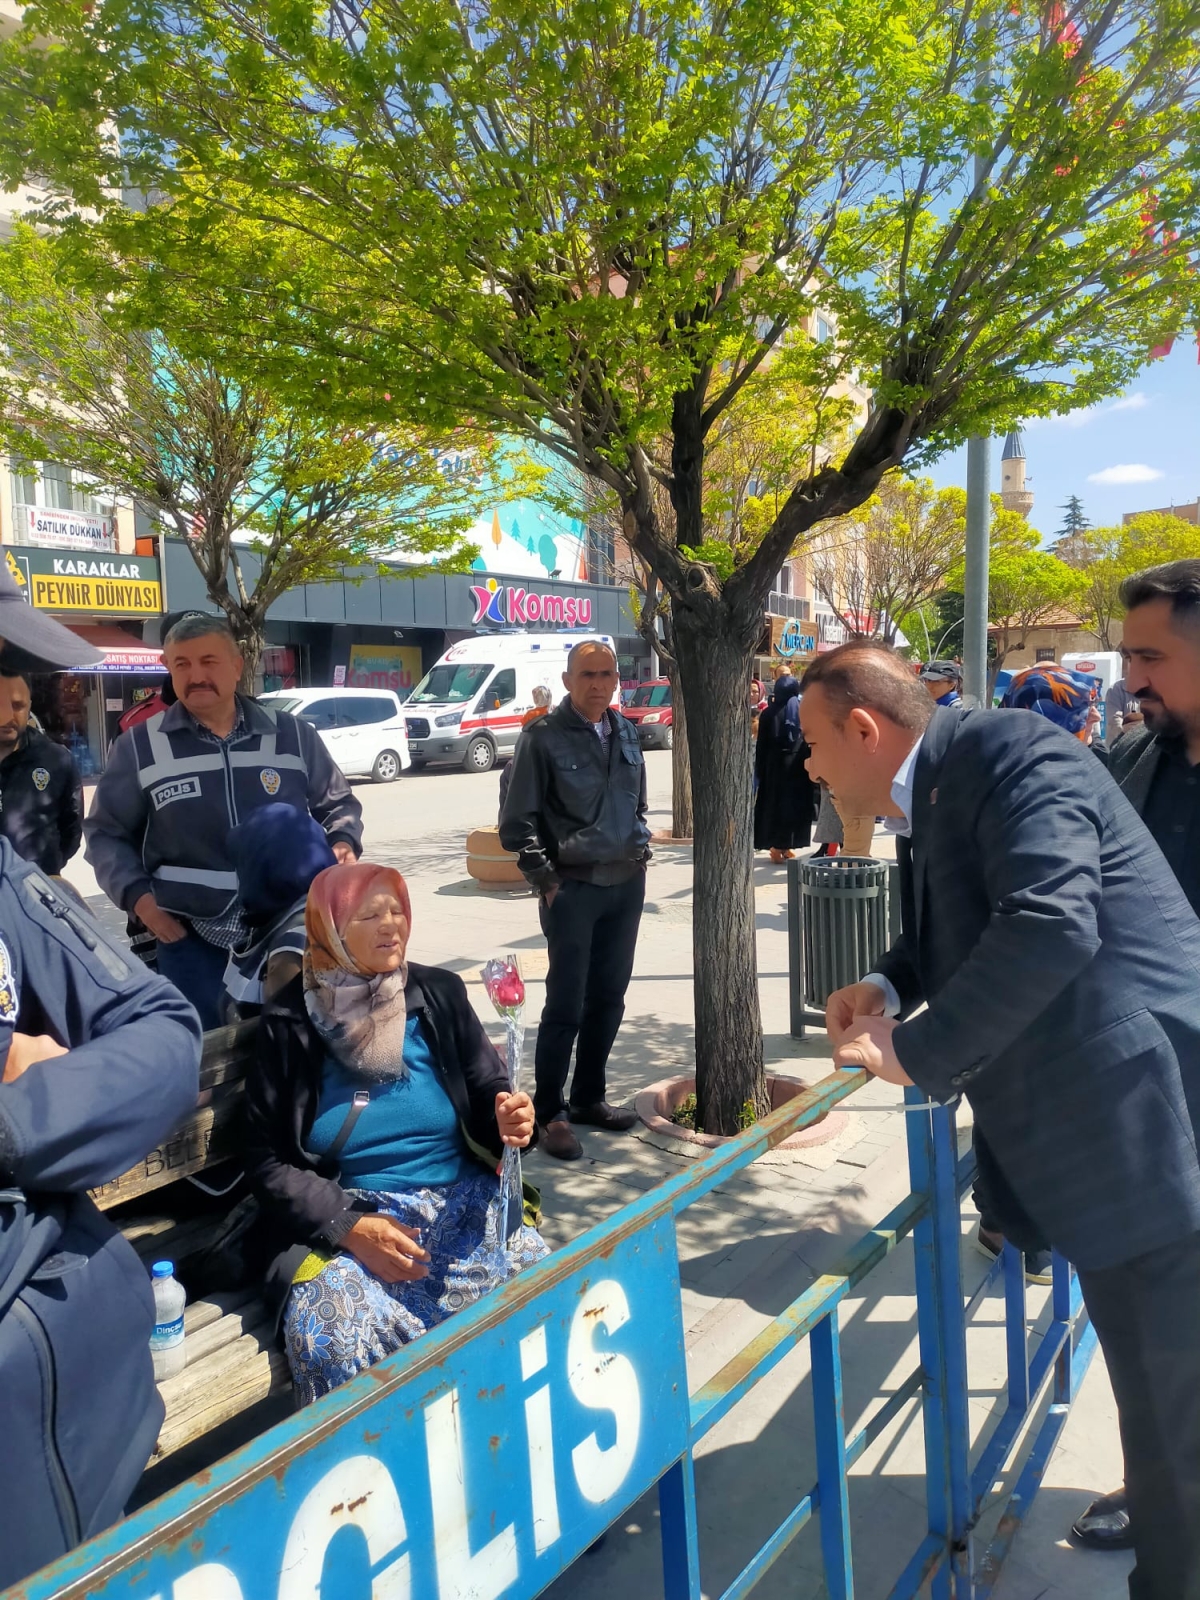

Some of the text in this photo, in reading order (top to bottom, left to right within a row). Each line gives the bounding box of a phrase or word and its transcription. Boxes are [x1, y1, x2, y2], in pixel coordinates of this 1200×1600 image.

[37, 520, 68, 535] SATILIK
[69, 523, 102, 539] DÜKKAN
[53, 558, 141, 579] KARAKLAR
[95, 582, 158, 608] DÜNYASI
[507, 586, 591, 628] Komşu
[128, 655, 158, 664] NOKTASI
